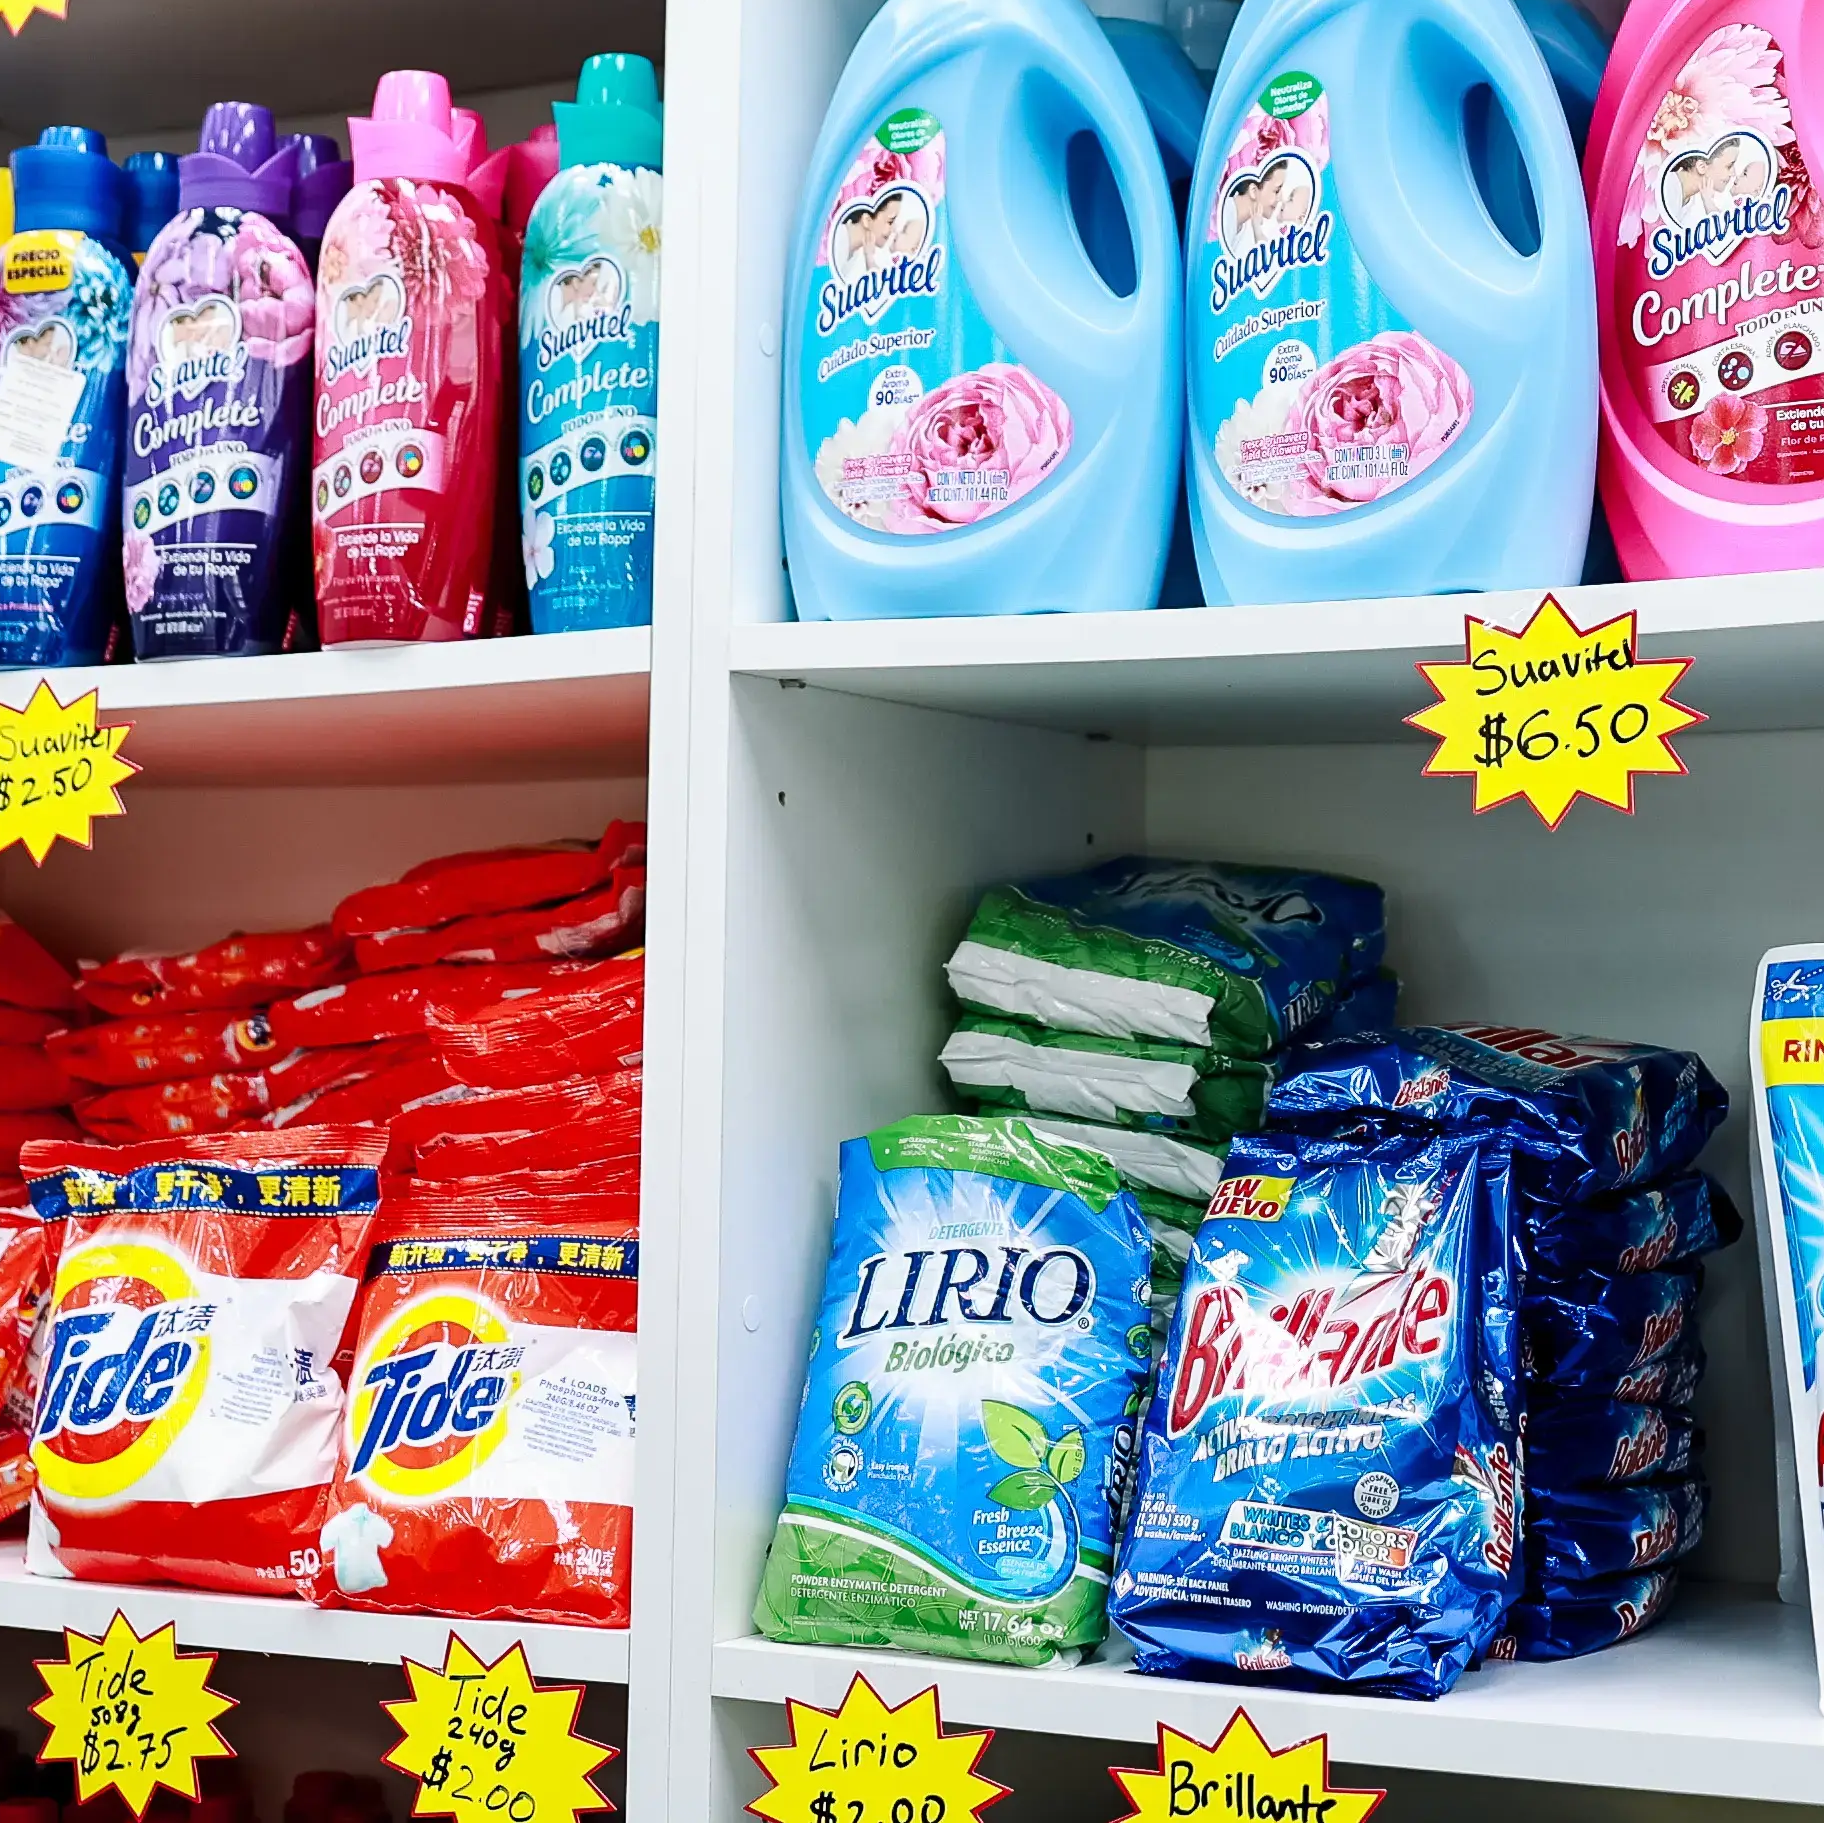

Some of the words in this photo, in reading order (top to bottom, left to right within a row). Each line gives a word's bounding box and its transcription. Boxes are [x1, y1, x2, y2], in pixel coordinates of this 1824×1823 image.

[13, 248, 60, 264] PRECIO
[1648, 187, 1793, 279] Suavitel
[818, 246, 942, 336] Suavitel
[1209, 212, 1331, 315] Suavitel
[325, 320, 409, 383] Suavitel
[537, 304, 632, 372] Suavitel
[145, 347, 246, 409] Suavitel
[526, 364, 649, 425] Complete
[133, 400, 264, 457] Complete
[315, 379, 427, 439] Complete
[1472, 638, 1634, 696] Suavitel
[1474, 703, 1649, 768] $6.50
[37, 1308, 193, 1438] Tide
[570, 1379, 608, 1395] LOADS
[351, 1348, 507, 1478] Tide
[972, 1507, 1010, 1525] Fresh
[978, 1537, 1032, 1555] Essence
[996, 1522, 1044, 1540] Breeze
[790, 1587, 852, 1603] DETERGENTE
[791, 1574, 829, 1588] POWDER
[830, 1577, 888, 1595] ENZYMATIC
[889, 1583, 947, 1599] DETERGENT
[76, 1650, 153, 1703] Tide
[449, 1674, 527, 1735] Tide
[80, 1727, 188, 1775] $2.75
[448, 1718, 516, 1771] 240g
[808, 1728, 919, 1773] Lirio
[422, 1746, 536, 1822] $2.00
[1170, 1760, 1337, 1821] Brillante
